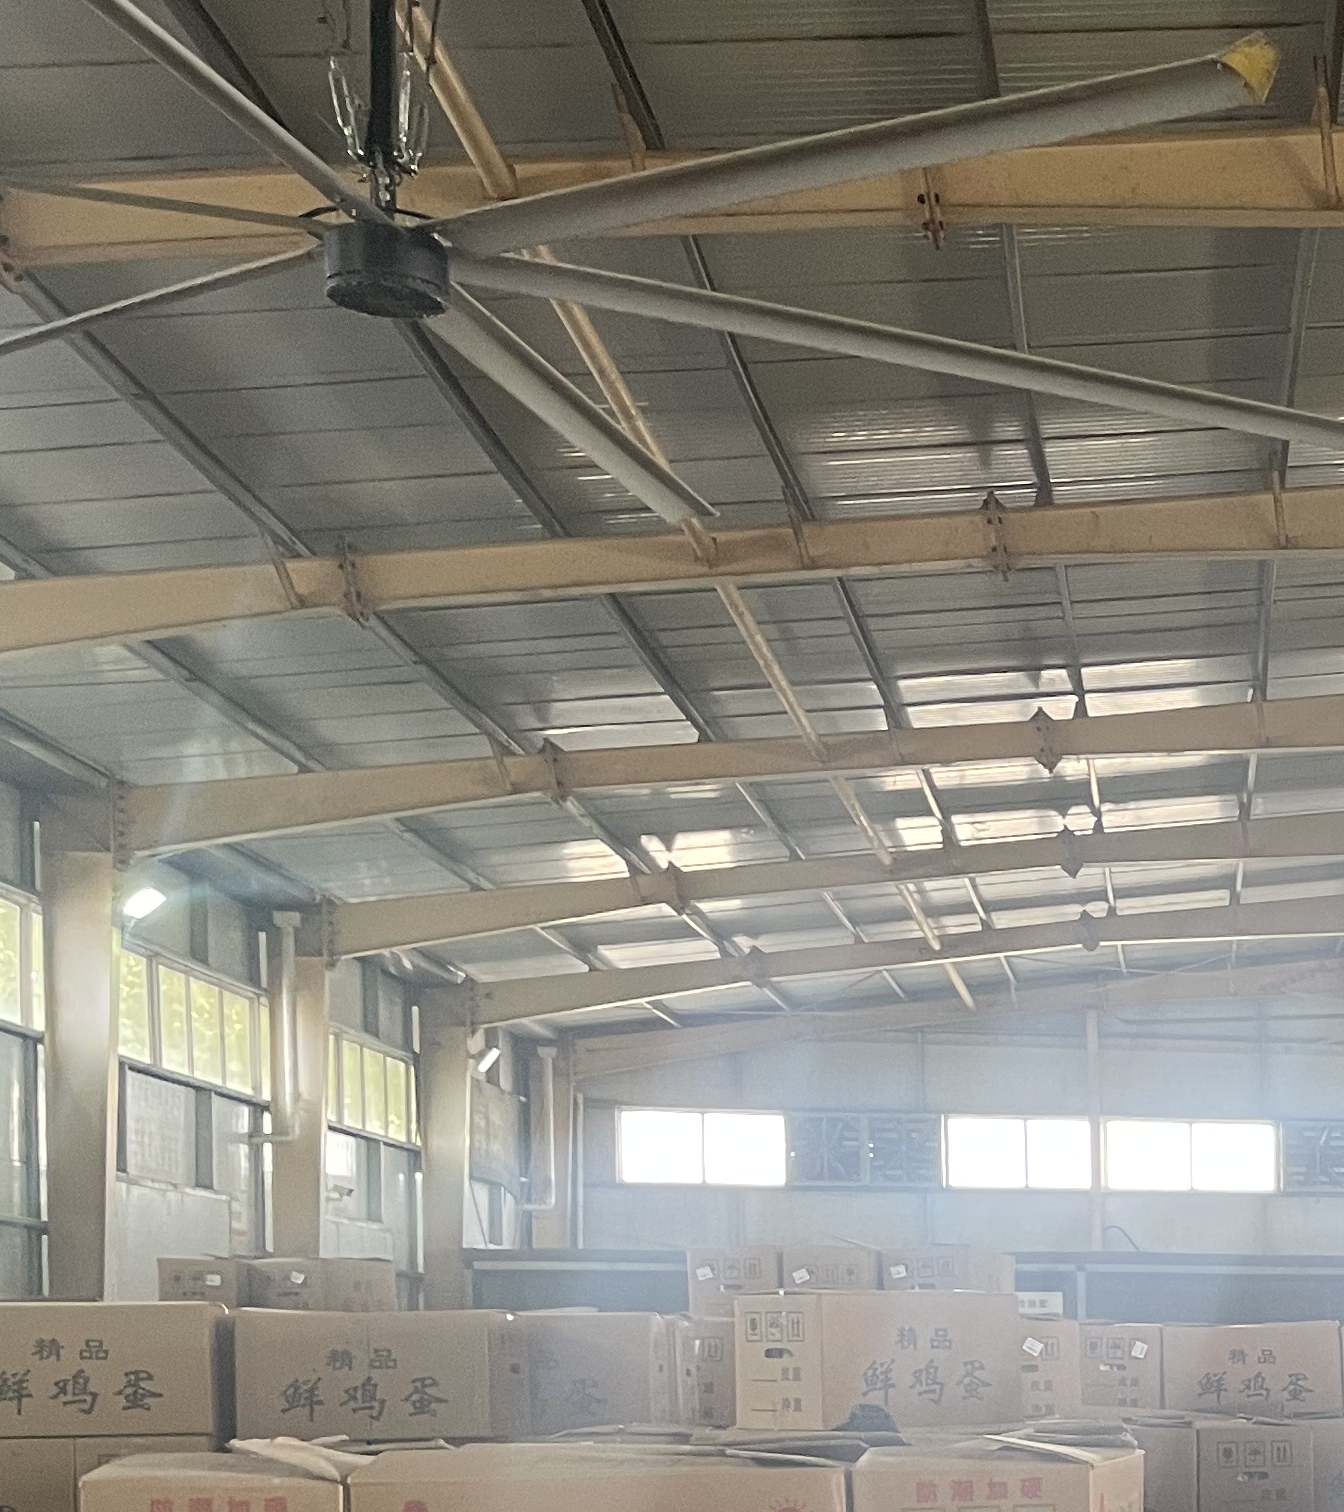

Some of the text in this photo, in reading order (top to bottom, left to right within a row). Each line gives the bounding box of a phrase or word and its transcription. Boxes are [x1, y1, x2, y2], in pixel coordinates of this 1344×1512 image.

[32, 1337, 110, 1362] 精品
[895, 1325, 953, 1351] 精品
[325, 1347, 398, 1371] 精品
[1228, 1348, 1278, 1366] 精品
[0, 1369, 164, 1416] 鲜鸡蛋
[861, 1358, 993, 1407] 鲜鸡蛋
[1197, 1370, 1315, 1407] 鲜鸡蛋
[281, 1375, 449, 1423] 鲜鸡蛋
